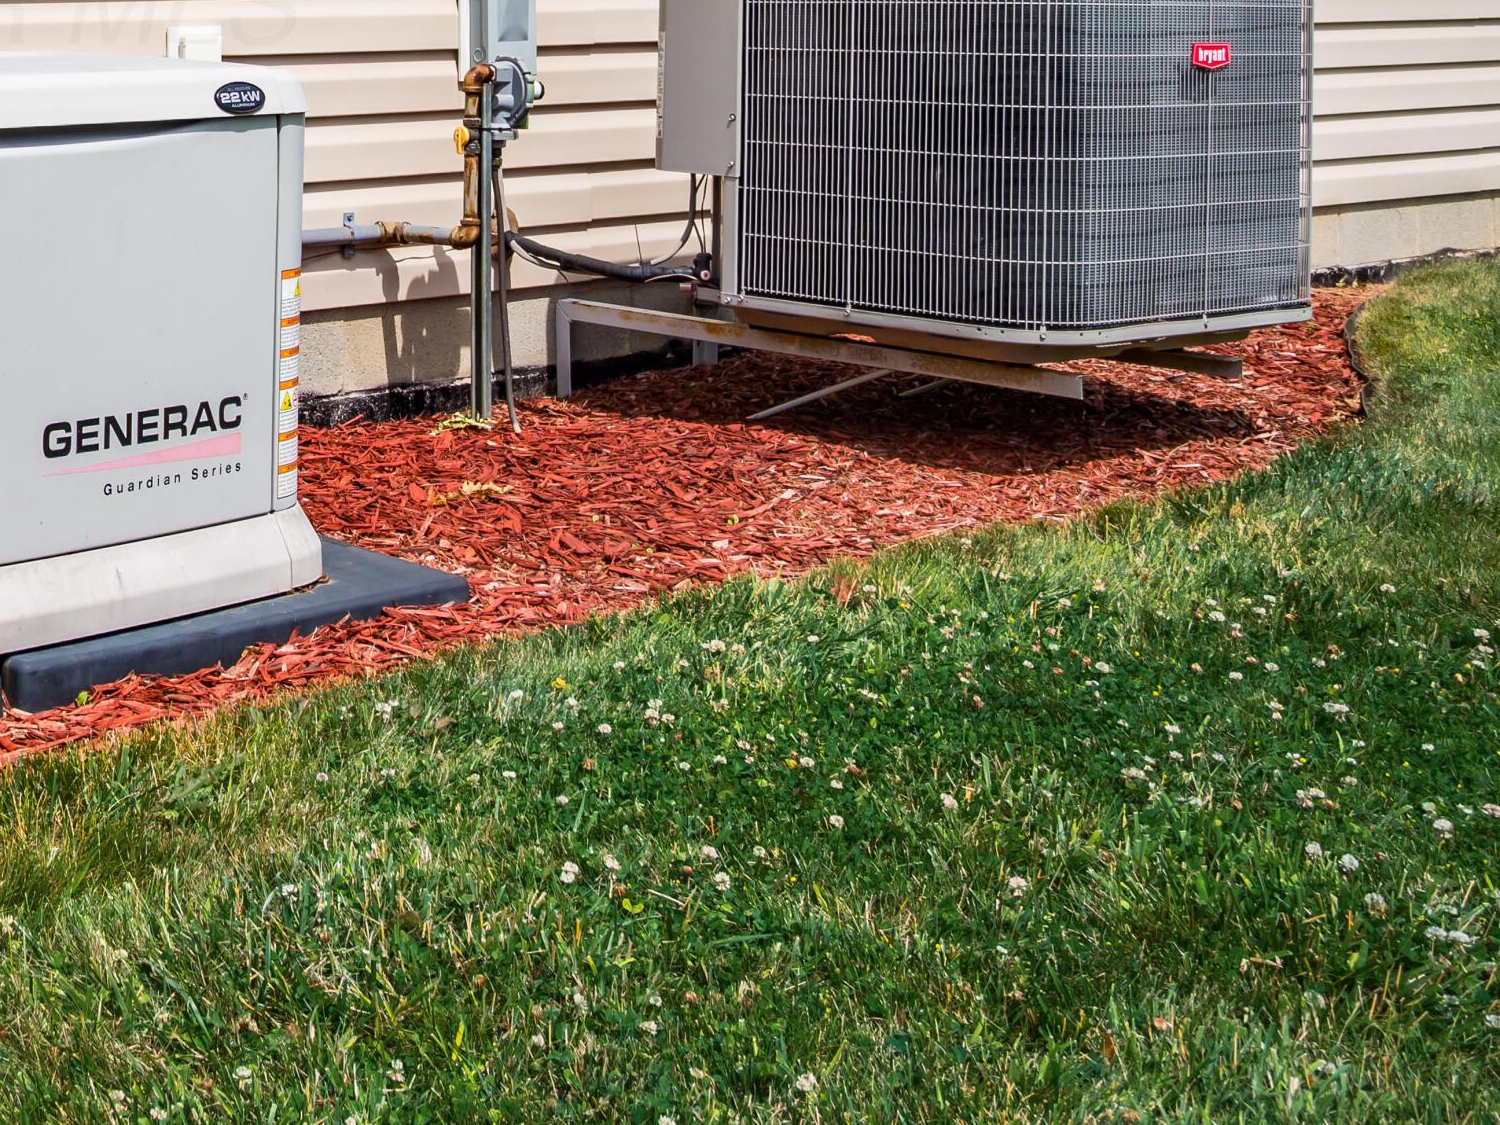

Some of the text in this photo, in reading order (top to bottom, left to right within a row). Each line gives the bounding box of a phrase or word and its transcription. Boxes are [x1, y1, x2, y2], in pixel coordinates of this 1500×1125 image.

[1197, 47, 1226, 63] bryant
[42, 395, 242, 459] GENERAC
[103, 462, 242, 497] Guardian Series
